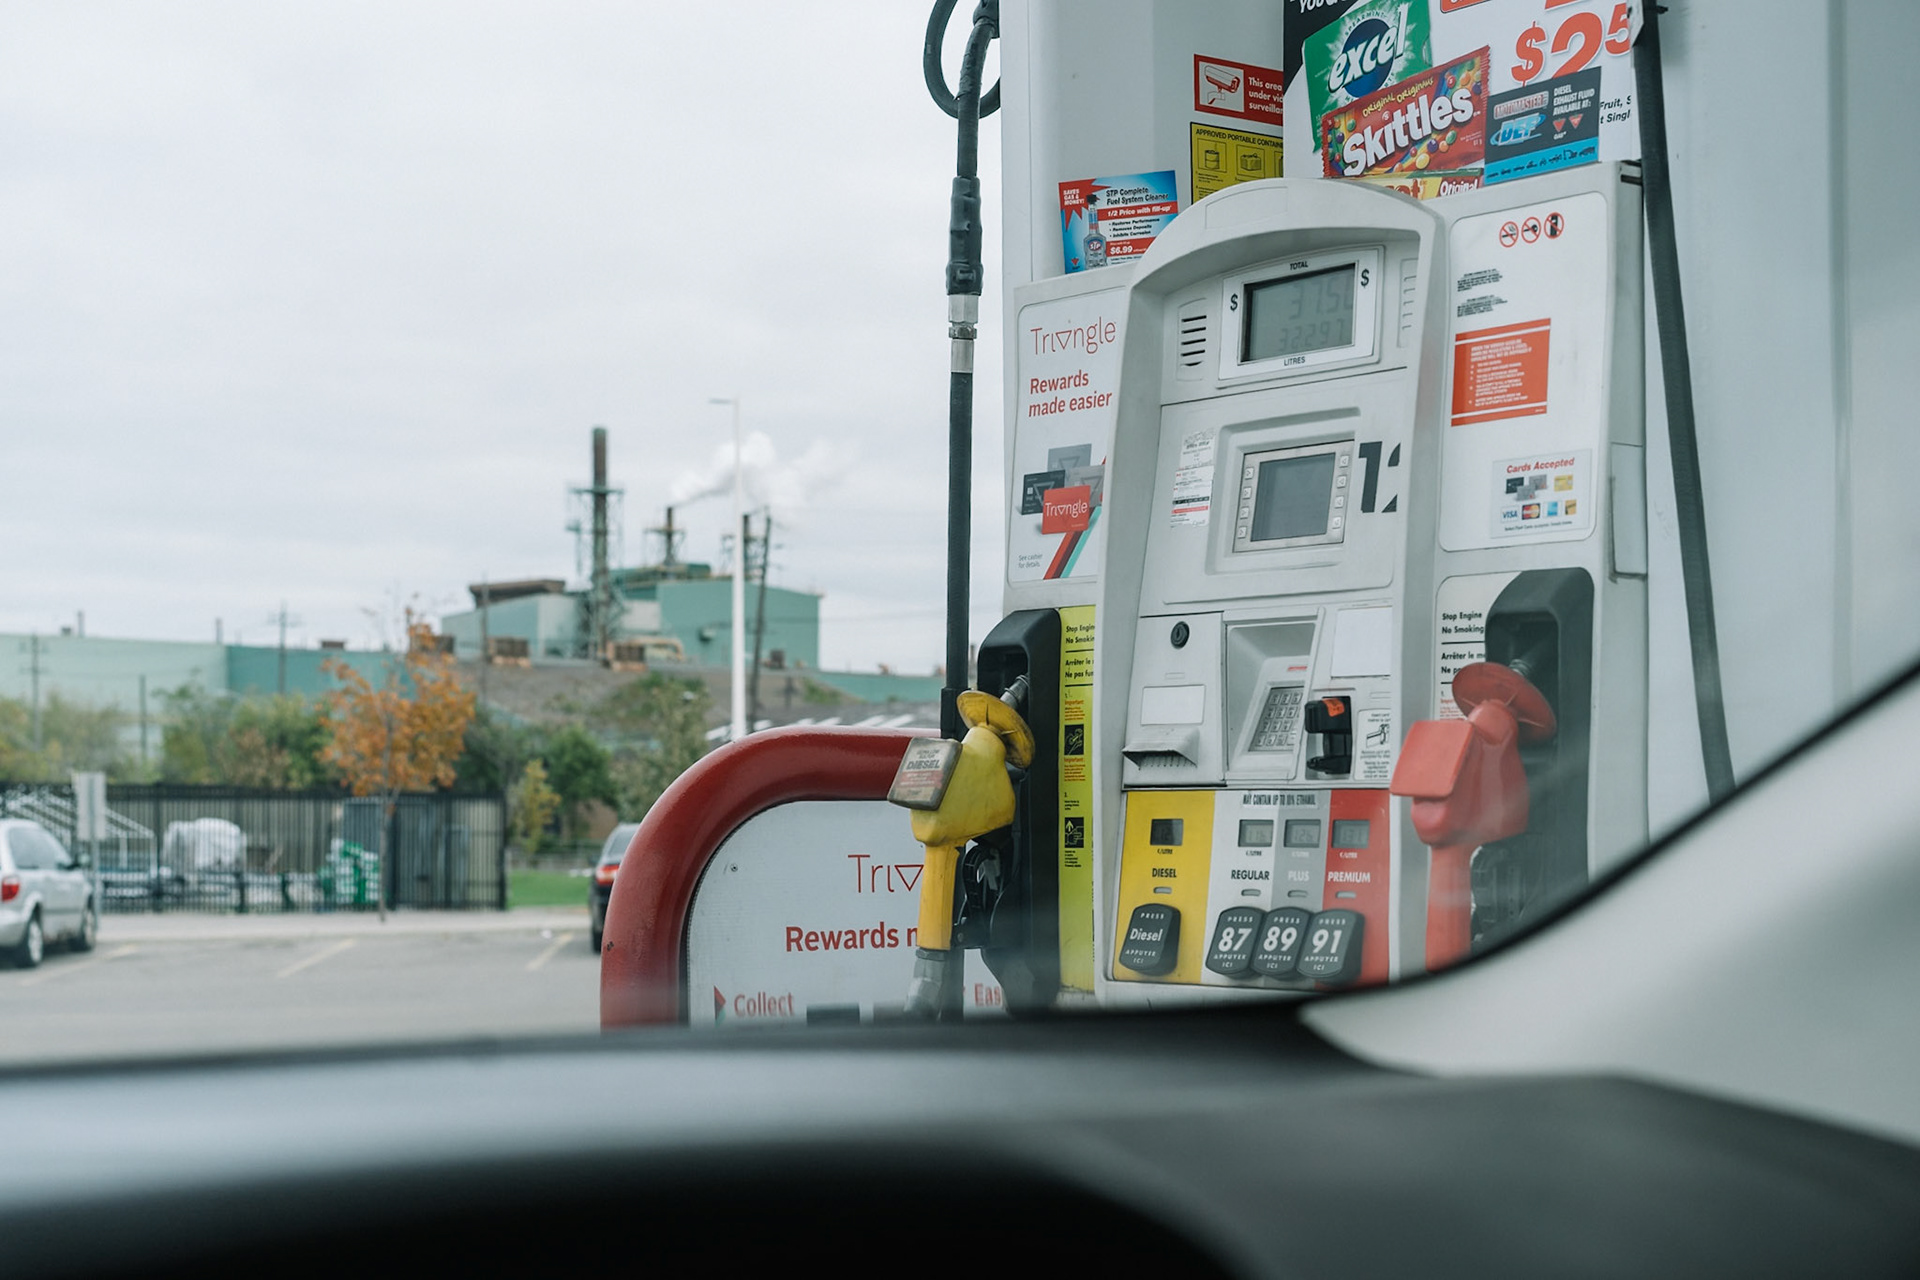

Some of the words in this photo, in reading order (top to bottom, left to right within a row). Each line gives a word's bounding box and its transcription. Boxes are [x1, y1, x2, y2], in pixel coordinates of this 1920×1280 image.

[1328, 3, 1409, 93] excel
[1248, 76, 1264, 88] This
[1264, 82, 1282, 91] area
[1248, 90, 1271, 101] under
[1272, 93, 1283, 103] vid
[1554, 84, 1572, 97] DIESEL
[1578, 88, 1595, 100] FLUID
[1248, 102, 1283, 114] surveilla
[1607, 109, 1630, 123] Singl
[1342, 88, 1474, 176] Skittles
[1499, 113, 1540, 144] DEF
[1196, 128, 1227, 140] APPROVED
[1227, 133, 1256, 144] PORTABLE
[1256, 138, 1283, 148] CONTAINE
[1106, 189, 1118, 198] STP
[1119, 187, 1149, 197] Complete
[1440, 178, 1479, 196] Original
[1106, 198, 1120, 206] Fuel
[1120, 196, 1144, 206] System
[1144, 193, 1169, 201] Cleaner
[1119, 208, 1136, 216] Price
[1136, 206, 1151, 214] with
[1109, 245, 1133, 255] $6.99
[1289, 261, 1309, 270] TOTAL
[1360, 268, 1370, 288] $
[1229, 293, 1239, 313] $
[1283, 356, 1306, 366] LITRES
[1030, 369, 1089, 394] Rewards
[1028, 396, 1066, 417] made
[1069, 391, 1113, 411] easier
[1506, 463, 1531, 474] Cards
[1533, 457, 1575, 471] Accepted
[1502, 510, 1518, 519] VISA
[1442, 613, 1458, 622] Stop
[1459, 611, 1482, 621] Engine
[1066, 625, 1078, 634] Stop
[1441, 626, 1452, 634] No
[1454, 625, 1485, 635] Smoking
[1075, 635, 1095, 644] Smoki
[1085, 658, 1091, 666] le
[1441, 652, 1466, 661] Arrêter
[1468, 651, 1475, 659] le
[1074, 671, 1084, 680] pas
[1441, 666, 1451, 674] Ne
[906, 760, 940, 770] DIESEL
[1253, 794, 1272, 805] CONTAIN
[1272, 794, 1279, 805] UP
[1296, 794, 1316, 805] ETHANOL
[847, 853, 925, 893] Tria
[1152, 868, 1177, 878] DIESEL
[1231, 870, 1270, 880] REGULAR
[1288, 871, 1310, 882] PLUS
[1327, 871, 1371, 883] PREMIUM
[1140, 912, 1165, 920] PRESS
[1273, 916, 1301, 924] PRESS
[1319, 918, 1347, 926] PRESS
[785, 920, 899, 952] Rewards
[1129, 928, 1163, 942] Diesel
[1218, 926, 1252, 952] 87
[1263, 926, 1298, 952] 89
[1312, 928, 1343, 954] 91
[1125, 949, 1156, 957] APPUYER
[1304, 955, 1339, 963] APPUYER
[974, 982, 1002, 1007] Eas
[733, 991, 795, 1018] Collect
